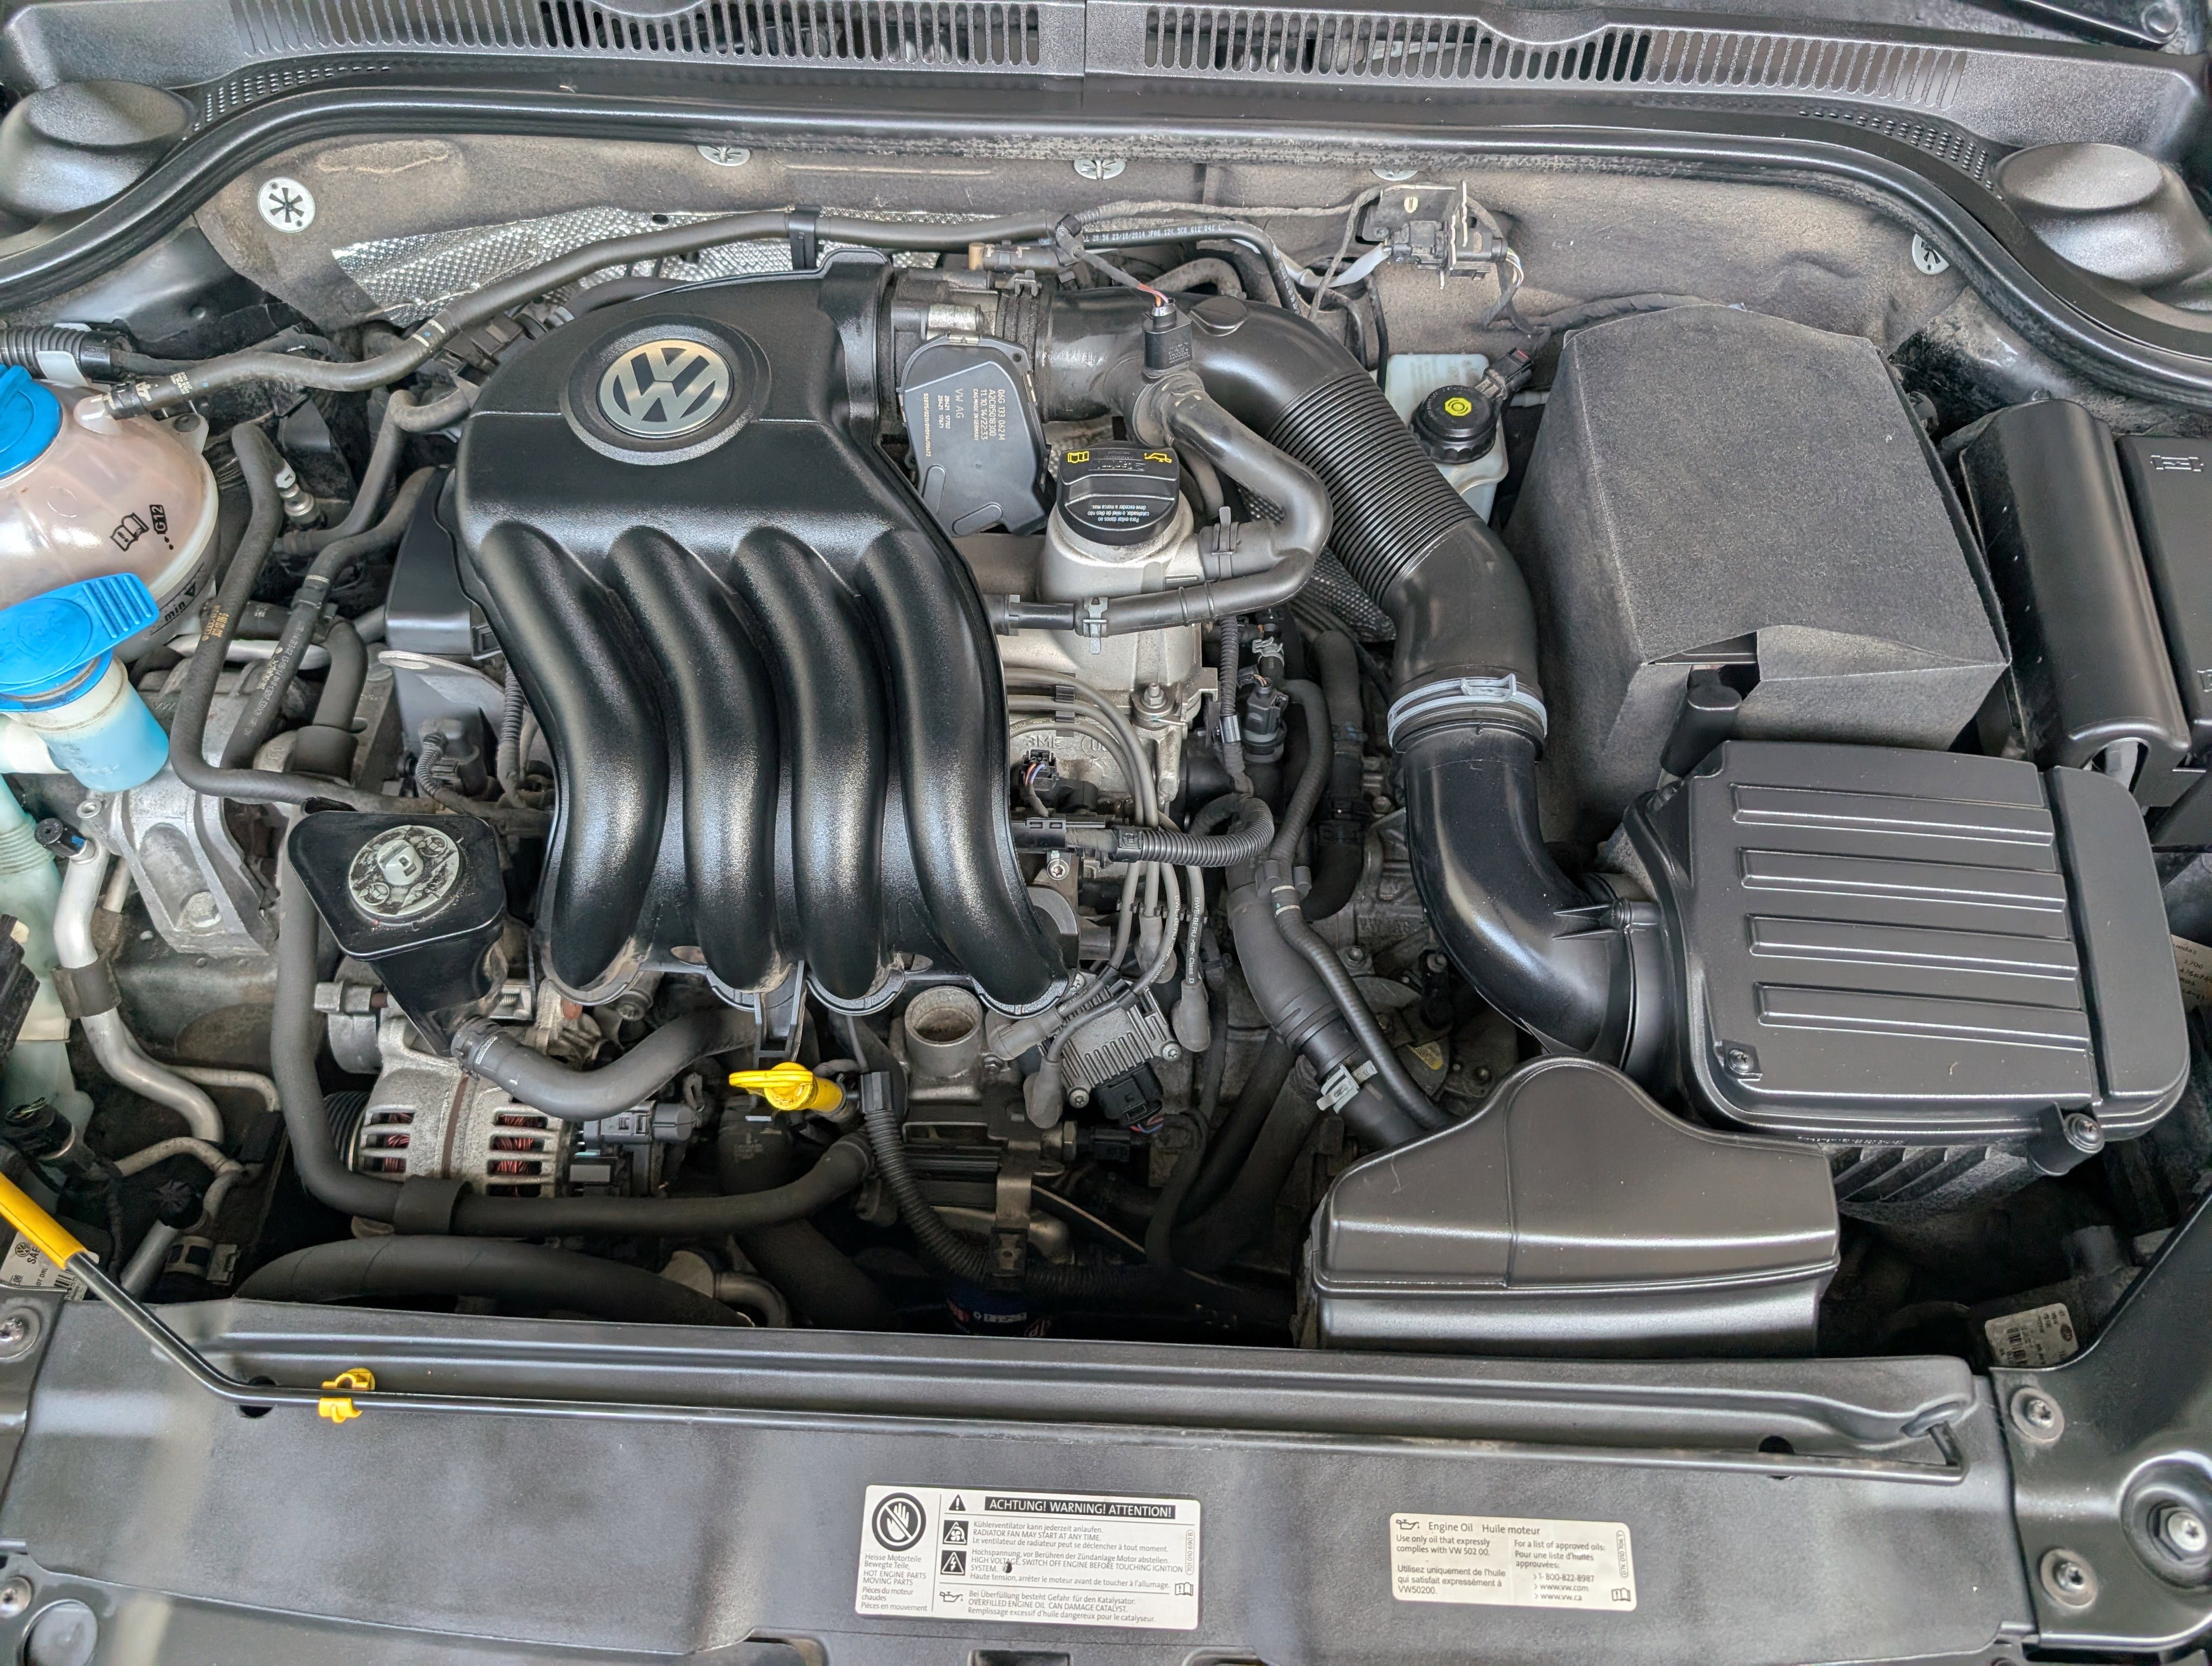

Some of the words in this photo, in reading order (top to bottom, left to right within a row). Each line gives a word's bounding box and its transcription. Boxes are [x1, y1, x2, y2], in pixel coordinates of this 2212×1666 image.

[1112, 232, 1146, 241] 23/10/2014
[955, 388, 963, 402] VW
[956, 406, 964, 419] AG
[151, 505, 166, 531] G12
[164, 601, 186, 623] min
[1172, 895, 1180, 940] BWE-BERU
[1191, 897, 1200, 937] BWE-BERU
[989, 1500, 1046, 1511] ACHTUNG!
[1050, 1502, 1105, 1514] WARNING!
[1109, 1504, 1172, 1516] ATTENTION!
[974, 1521, 1025, 1529] Kühlerventilator
[1044, 1524, 1071, 1533] jederzeit
[1429, 1522, 1458, 1533] Engine
[1461, 1523, 1472, 1531] Oil
[1482, 1524, 1506, 1533] Huile
[1507, 1525, 1540, 1534] moteur
[1058, 1541, 1072, 1549] peut
[1411, 1535, 1427, 1544] only
[1456, 1536, 1490, 1546] expressly
[1555, 1541, 1589, 1552] approved
[1397, 1545, 1429, 1555] complies
[1077, 1553, 1115, 1562] Zündanlage
[1398, 1565, 1424, 1573] Utilisez
[1426, 1566, 1471, 1577] uniquement
[1398, 1575, 1409, 1585] qui
[1411, 1575, 1439, 1584] satisfait
[1442, 1577, 1495, 1588] expressément
[981, 1591, 1019, 1600] Überfüllung
[1097, 1596, 1136, 1606] Katalysator.
[890, 1603, 927, 1611] mouvement
[968, 1607, 1008, 1616] Remplissage
[1060, 1611, 1095, 1620] dangereux
[1121, 1614, 1155, 1623] catalyseur.
